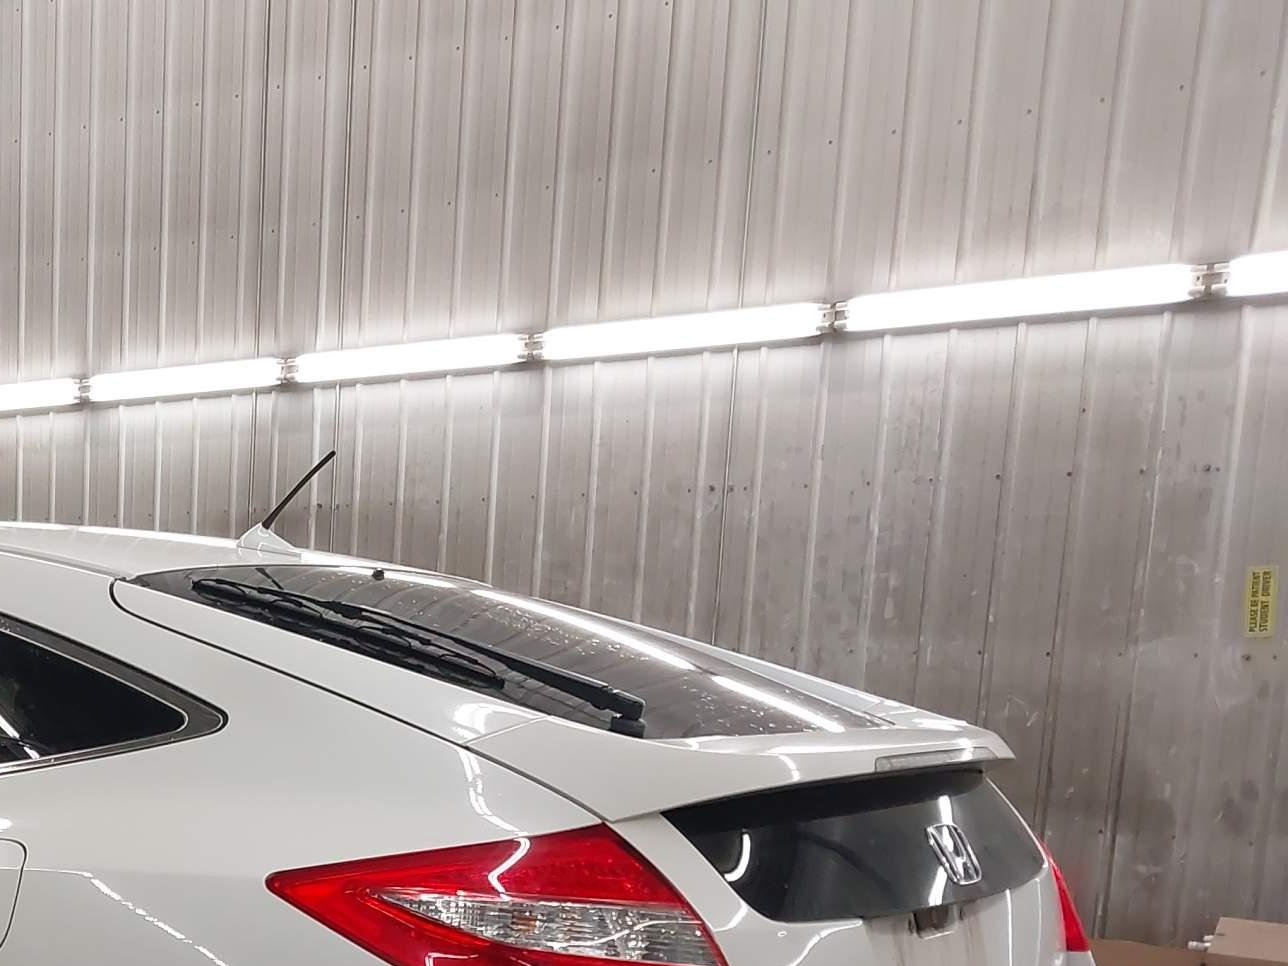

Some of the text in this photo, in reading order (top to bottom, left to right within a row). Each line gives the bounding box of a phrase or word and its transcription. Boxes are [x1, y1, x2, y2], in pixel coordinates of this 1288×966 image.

[1251, 571, 1261, 598] PATIENT
[1259, 571, 1272, 632] STUDENT DRIVER
[1249, 608, 1259, 632] PLEASE
